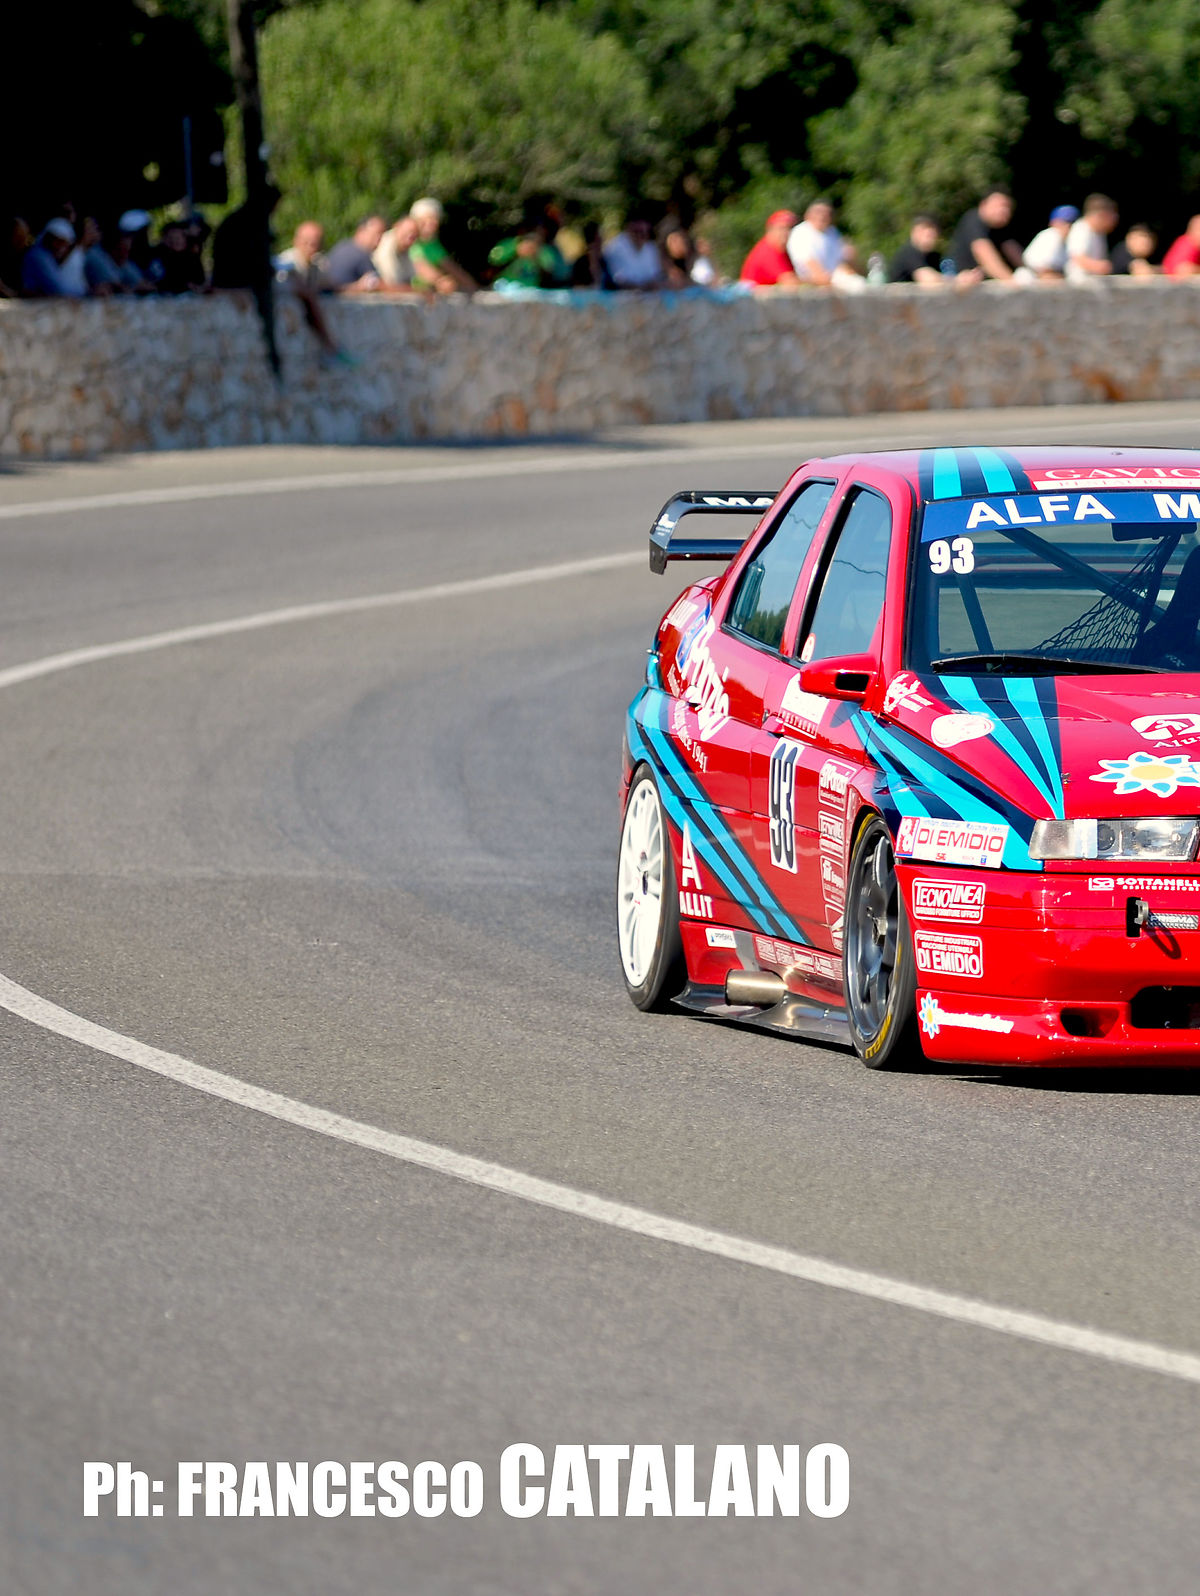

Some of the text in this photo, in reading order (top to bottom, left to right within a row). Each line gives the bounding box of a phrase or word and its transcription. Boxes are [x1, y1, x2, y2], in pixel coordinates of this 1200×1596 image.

[966, 494, 1116, 529] ALFA
[929, 537, 975, 575] 93
[771, 743, 798, 869] 93
[917, 828, 935, 845] DI
[936, 830, 1004, 853] EMIDIO
[680, 891, 713, 918] ALLIT
[1150, 914, 1195, 925] PRISMA
[918, 948, 980, 975] DI EMIDIO
